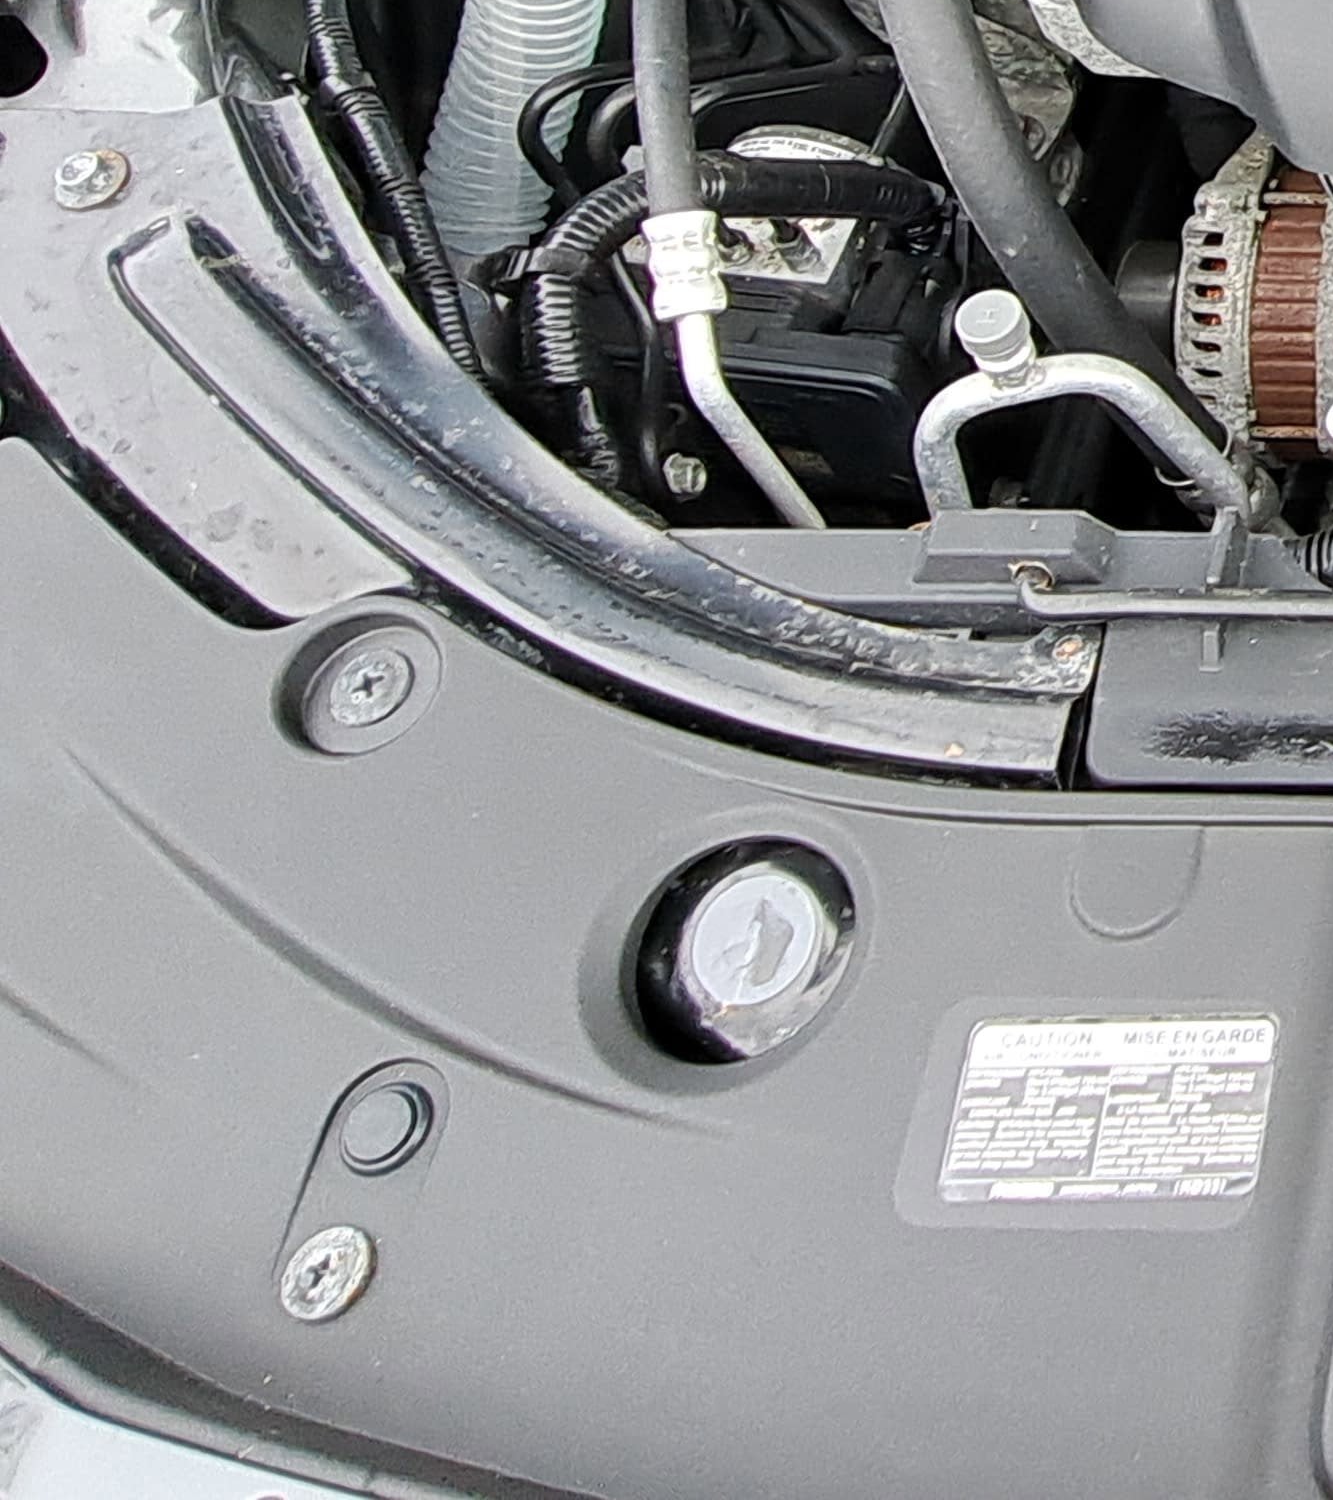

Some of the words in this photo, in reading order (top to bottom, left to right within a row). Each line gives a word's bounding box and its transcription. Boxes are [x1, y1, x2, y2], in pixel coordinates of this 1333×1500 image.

[1001, 1029, 1093, 1048] CAUTION
[1123, 1029, 1166, 1045] MISE
[1172, 1028, 1198, 1044] EN
[1202, 1027, 1265, 1044] GARDE
